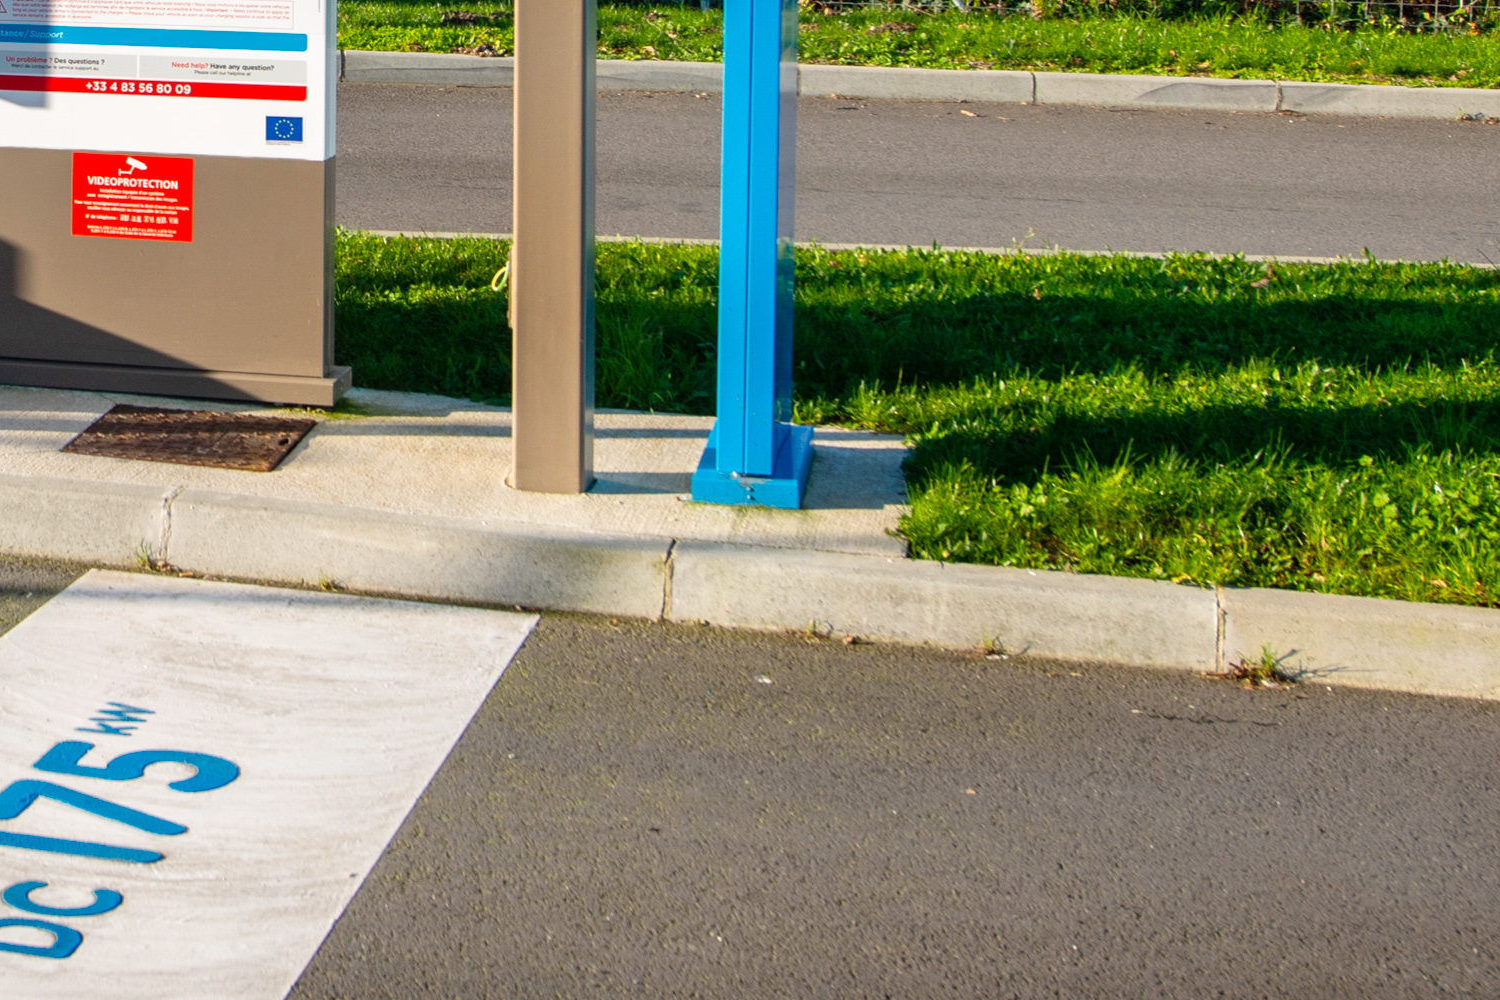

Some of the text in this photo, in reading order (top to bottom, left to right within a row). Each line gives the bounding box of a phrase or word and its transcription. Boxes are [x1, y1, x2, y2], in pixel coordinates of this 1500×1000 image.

[30, 30, 64, 39] Support
[16, 56, 47, 64] problème
[68, 58, 100, 66] questions
[191, 62, 209, 70] help?
[242, 64, 275, 72] question?
[85, 81, 192, 95] +33 4 83 56 80 09
[87, 175, 178, 190] VIDEOPROTECTION
[75, 702, 155, 736] kW
